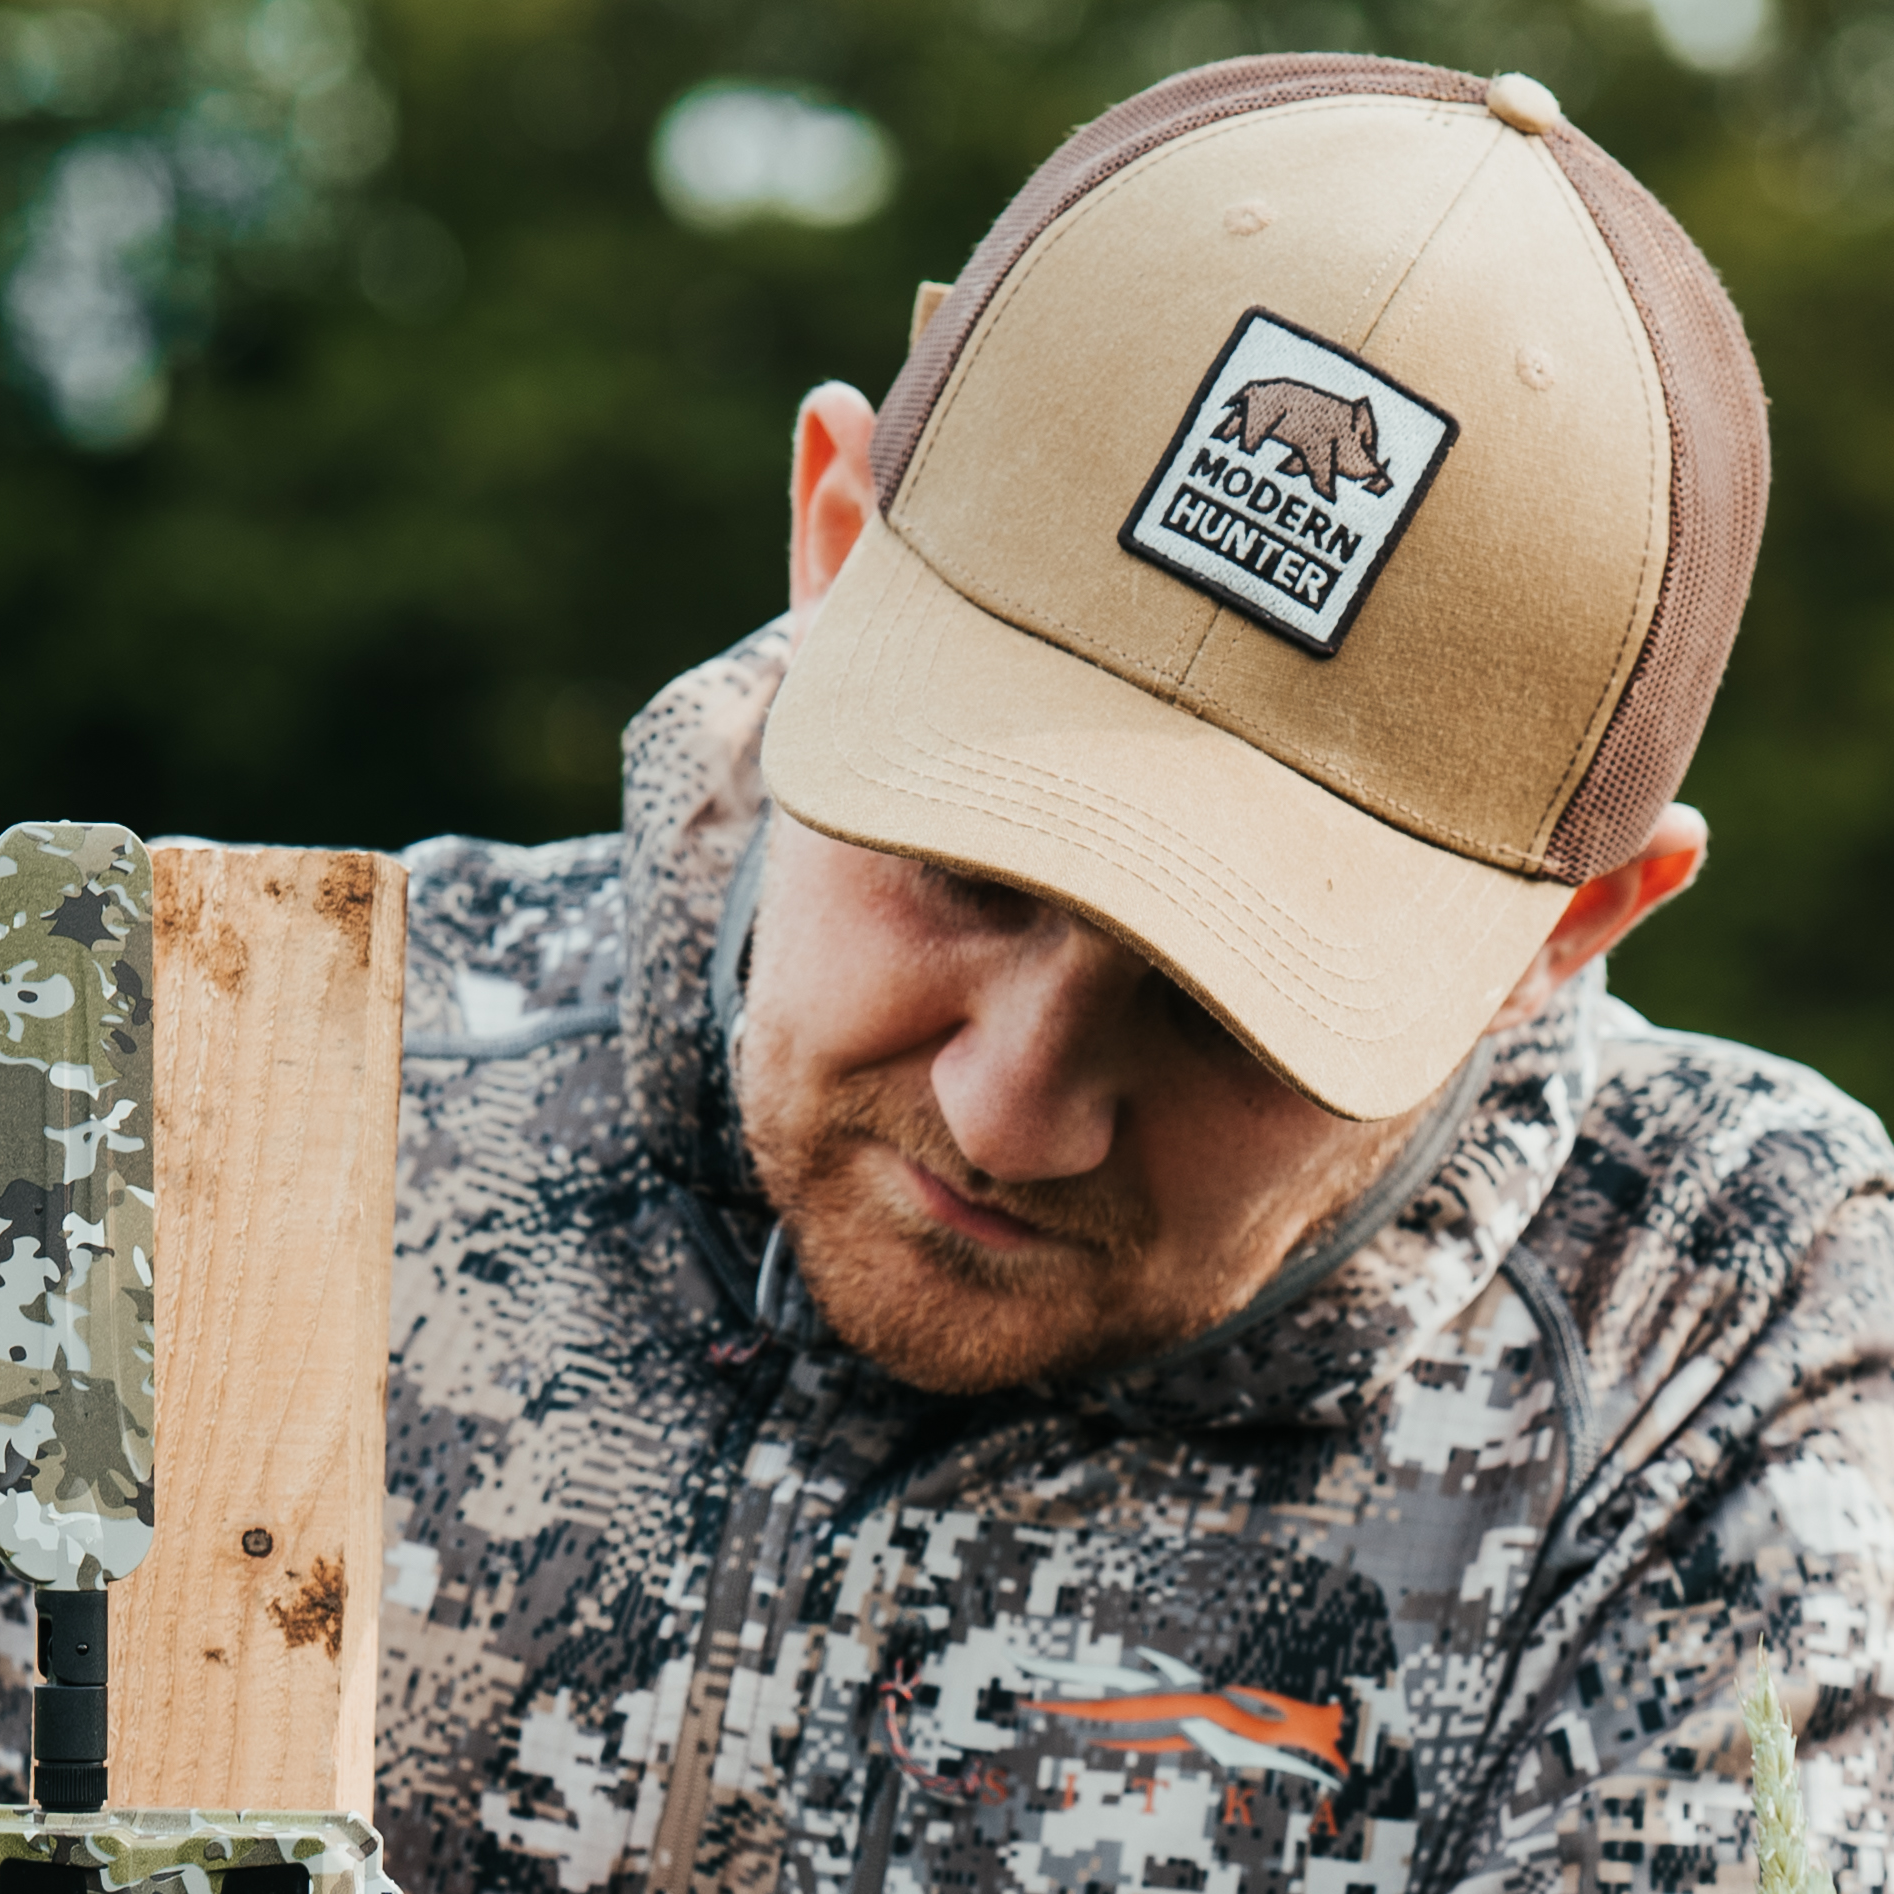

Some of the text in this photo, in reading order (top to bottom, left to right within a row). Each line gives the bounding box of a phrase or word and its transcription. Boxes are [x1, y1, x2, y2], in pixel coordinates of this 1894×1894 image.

[1169, 493, 1328, 604] HUNTER
[1188, 448, 1362, 563] MODERN
[981, 1768, 1340, 1837] SITKA
